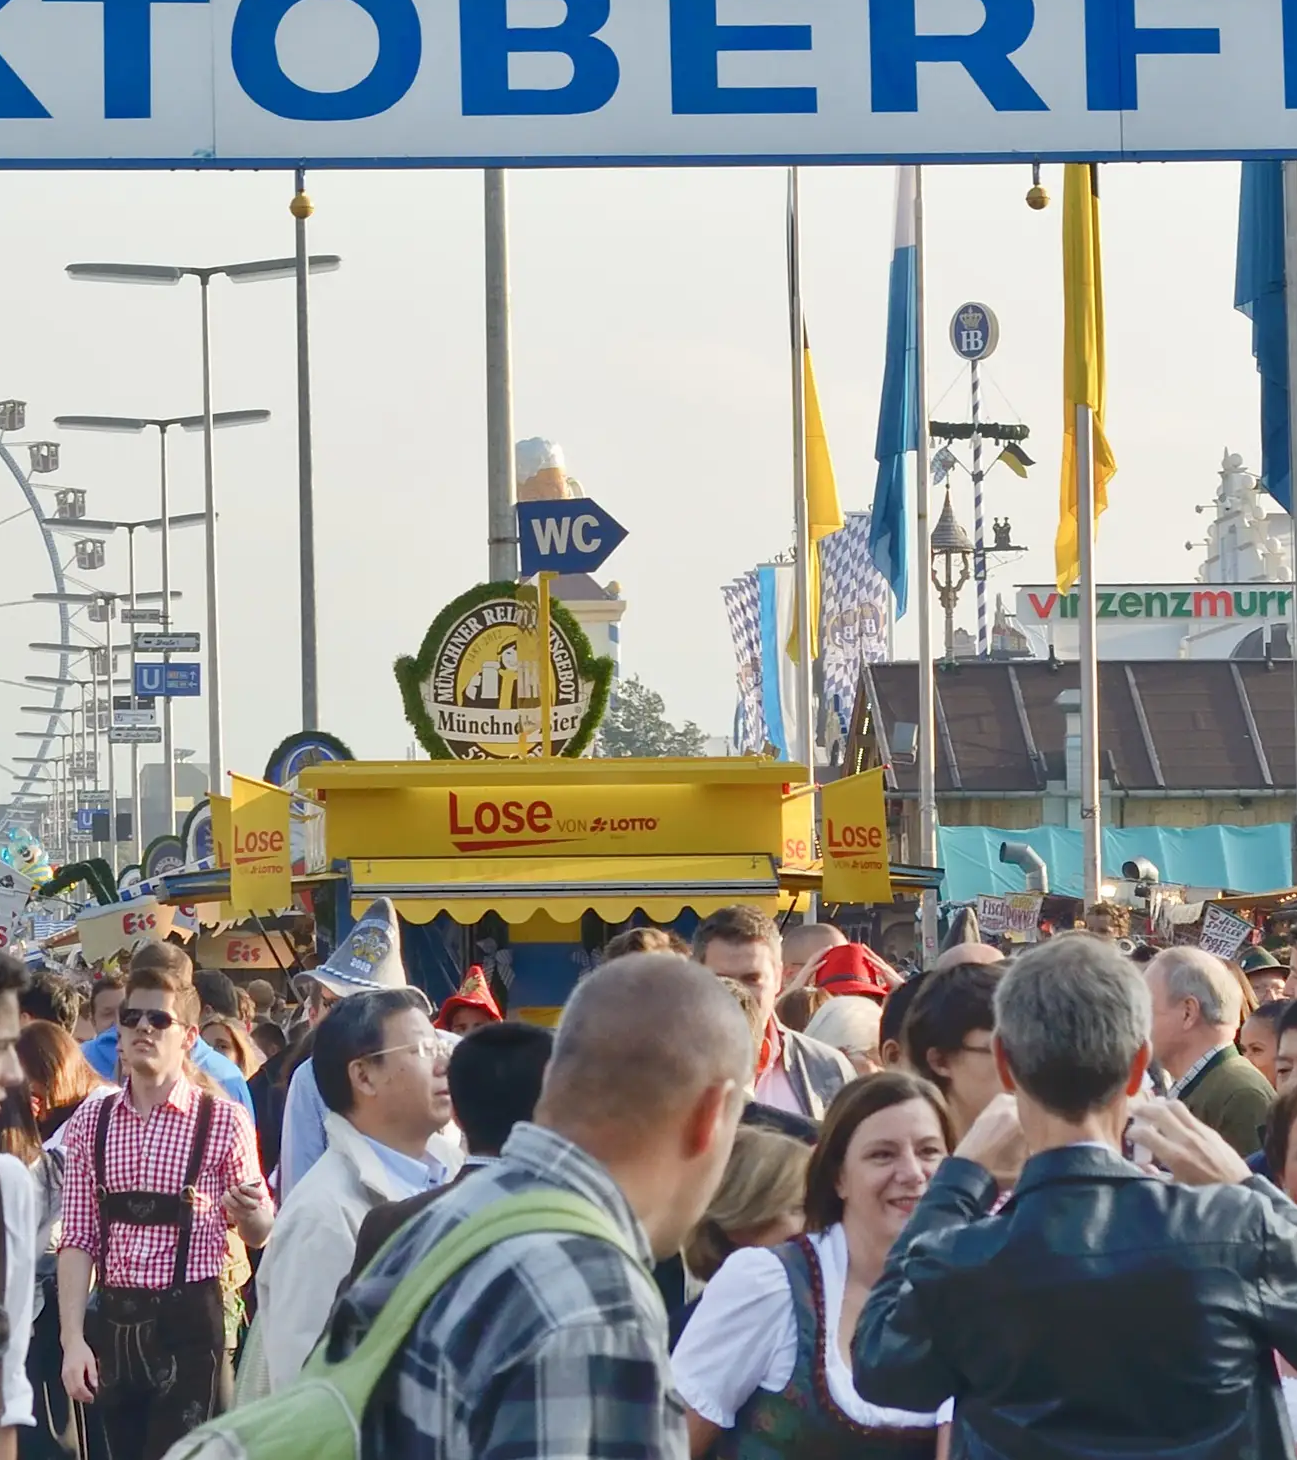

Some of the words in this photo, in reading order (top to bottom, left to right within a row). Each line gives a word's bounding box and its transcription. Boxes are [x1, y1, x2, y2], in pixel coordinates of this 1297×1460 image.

[531, 514, 602, 556] WC
[434, 616, 485, 702] MÜNCHNER
[482, 605, 576, 703] REITSGEBOT
[143, 669, 160, 690] U
[449, 790, 553, 835] Lose
[557, 818, 587, 833] VON
[610, 817, 658, 832] LOTTO
[234, 824, 285, 854] Lose
[827, 818, 883, 848] Lose
[860, 861, 883, 871] LOTTO
[122, 912, 157, 936] Eis
[226, 940, 261, 964] Eis
